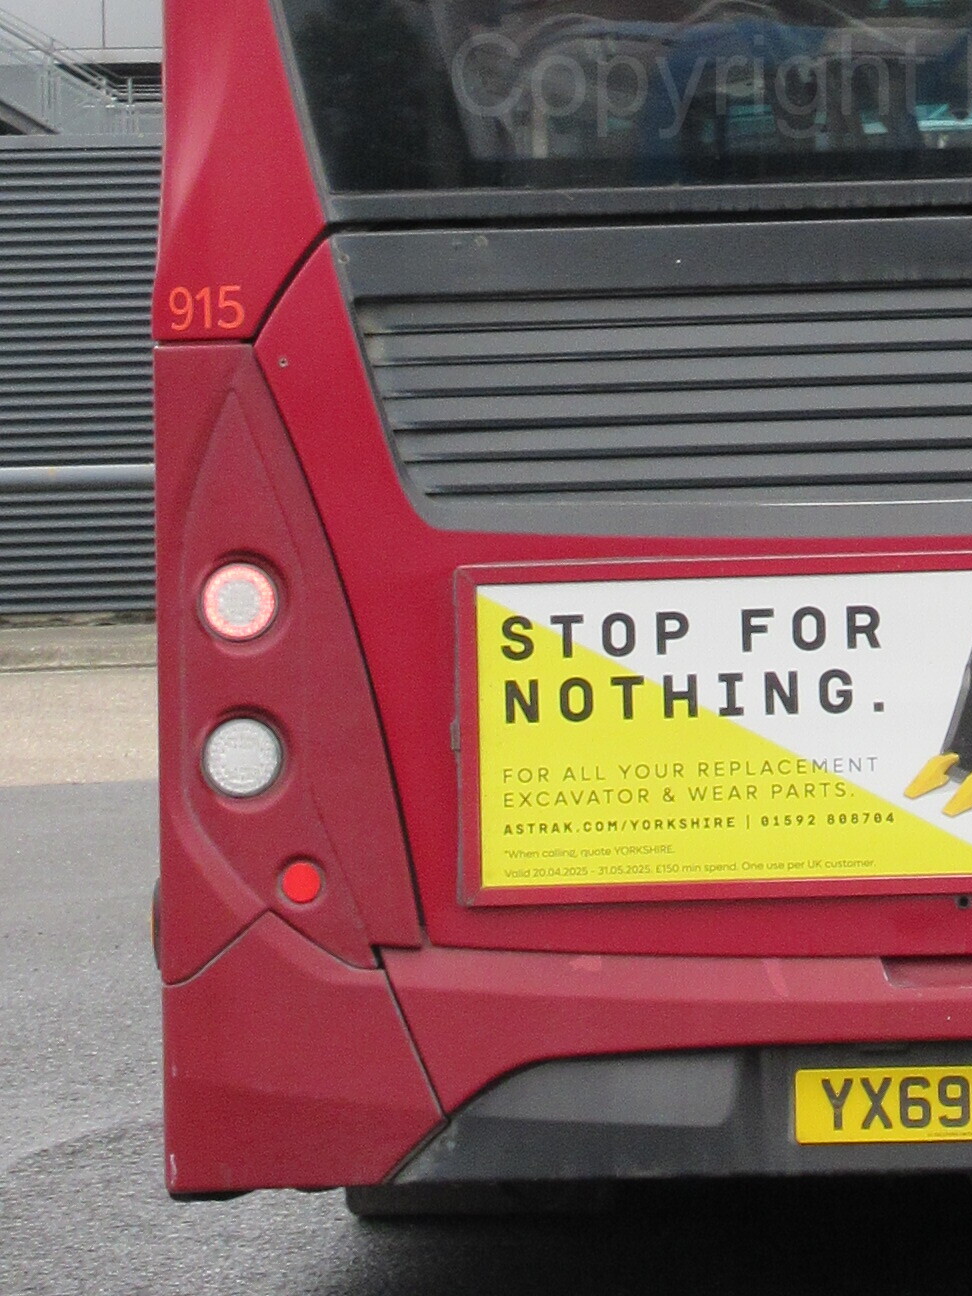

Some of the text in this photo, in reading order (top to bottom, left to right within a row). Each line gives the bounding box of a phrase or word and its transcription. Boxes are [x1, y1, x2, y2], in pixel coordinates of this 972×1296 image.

[169, 286, 245, 331] 915
[500, 606, 882, 661] STOP FOR
[504, 669, 885, 724] NOTHING.
[503, 757, 878, 784] FOR ALL YOUR REPLACEMENT
[503, 782, 855, 808] EXCAVATOR & WEAR PARTS.
[503, 816, 736, 835] ASTRAK.COM/YORKSHIRE
[760, 813, 816, 828] 01592
[580, 847, 612, 858] quote
[504, 868, 531, 879] Valid
[532, 866, 589, 879] 20.04.2025
[655, 863, 680, 873] £150
[681, 862, 702, 873] min
[741, 861, 765, 871] One
[766, 862, 786, 871] use
[787, 860, 806, 872] per
[808, 859, 823, 869] UK
[825, 858, 878, 870] customer.
[821, 1076, 971, 1131] YX69
